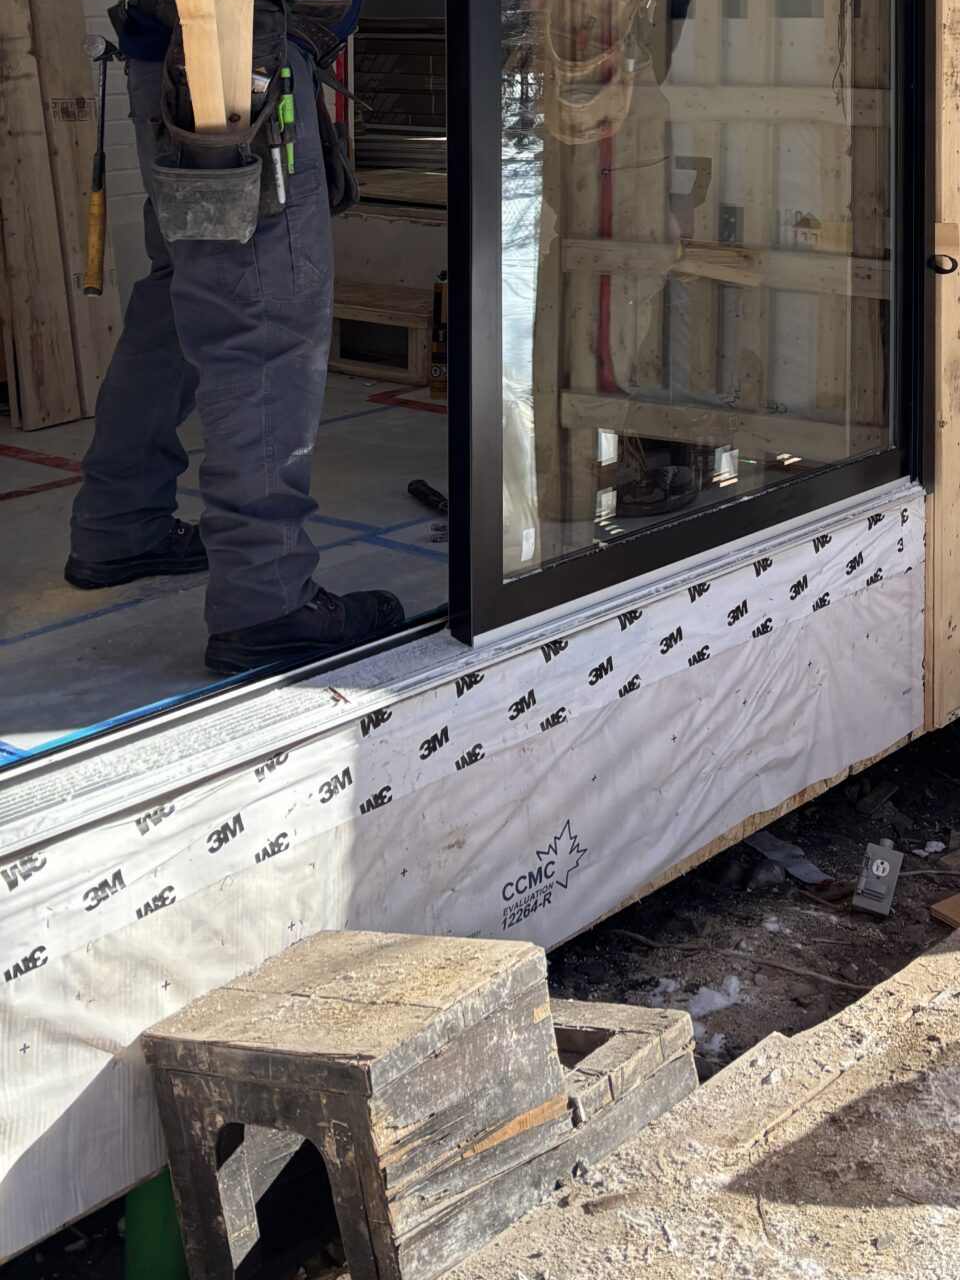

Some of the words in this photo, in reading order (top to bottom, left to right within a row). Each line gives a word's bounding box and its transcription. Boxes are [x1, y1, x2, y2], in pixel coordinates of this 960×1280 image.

[845, 551, 864, 576] 3M
[789, 574, 809, 601] 3M
[727, 599, 749, 627] 3M
[659, 626, 683, 655] 3M
[588, 655, 614, 686] 3M
[508, 688, 537, 721] 3M
[419, 725, 450, 761] 3M
[318, 766, 354, 804] 3M
[206, 812, 245, 854] 3M
[83, 868, 127, 912] 3M
[502, 860, 555, 901] CCMC
[501, 891, 552, 931] 12264-R
[503, 881, 554, 917] EVALUATION
